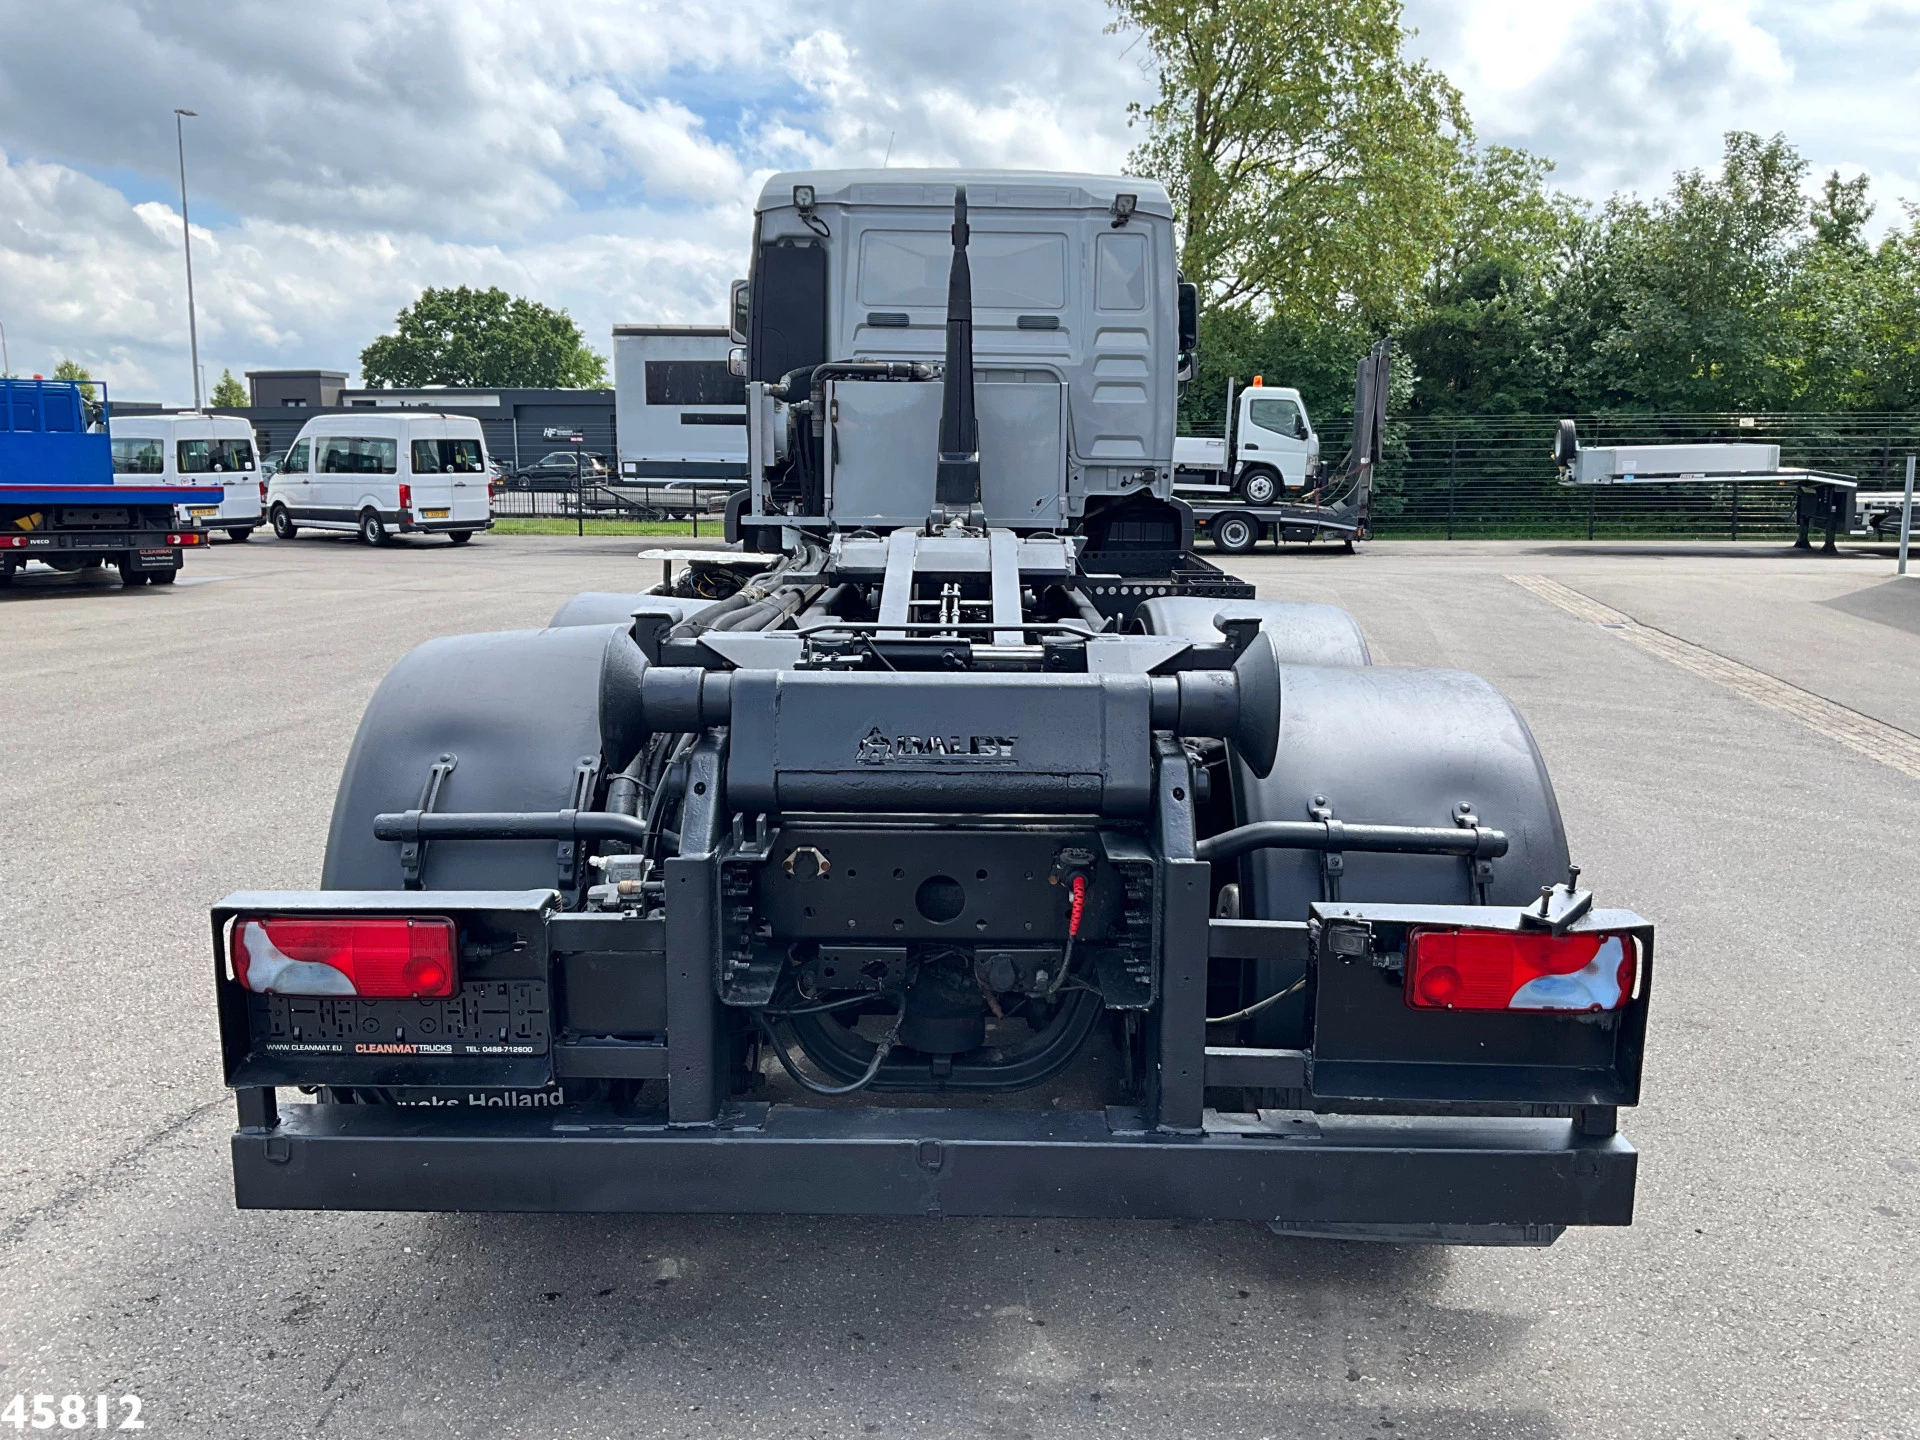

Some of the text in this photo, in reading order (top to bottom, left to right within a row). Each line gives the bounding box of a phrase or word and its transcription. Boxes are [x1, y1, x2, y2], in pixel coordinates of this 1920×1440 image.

[897, 735, 1019, 757] DALBY
[266, 1044, 342, 1052] WWW.CLEANMAT.EU
[468, 1087, 564, 1107] Holland
